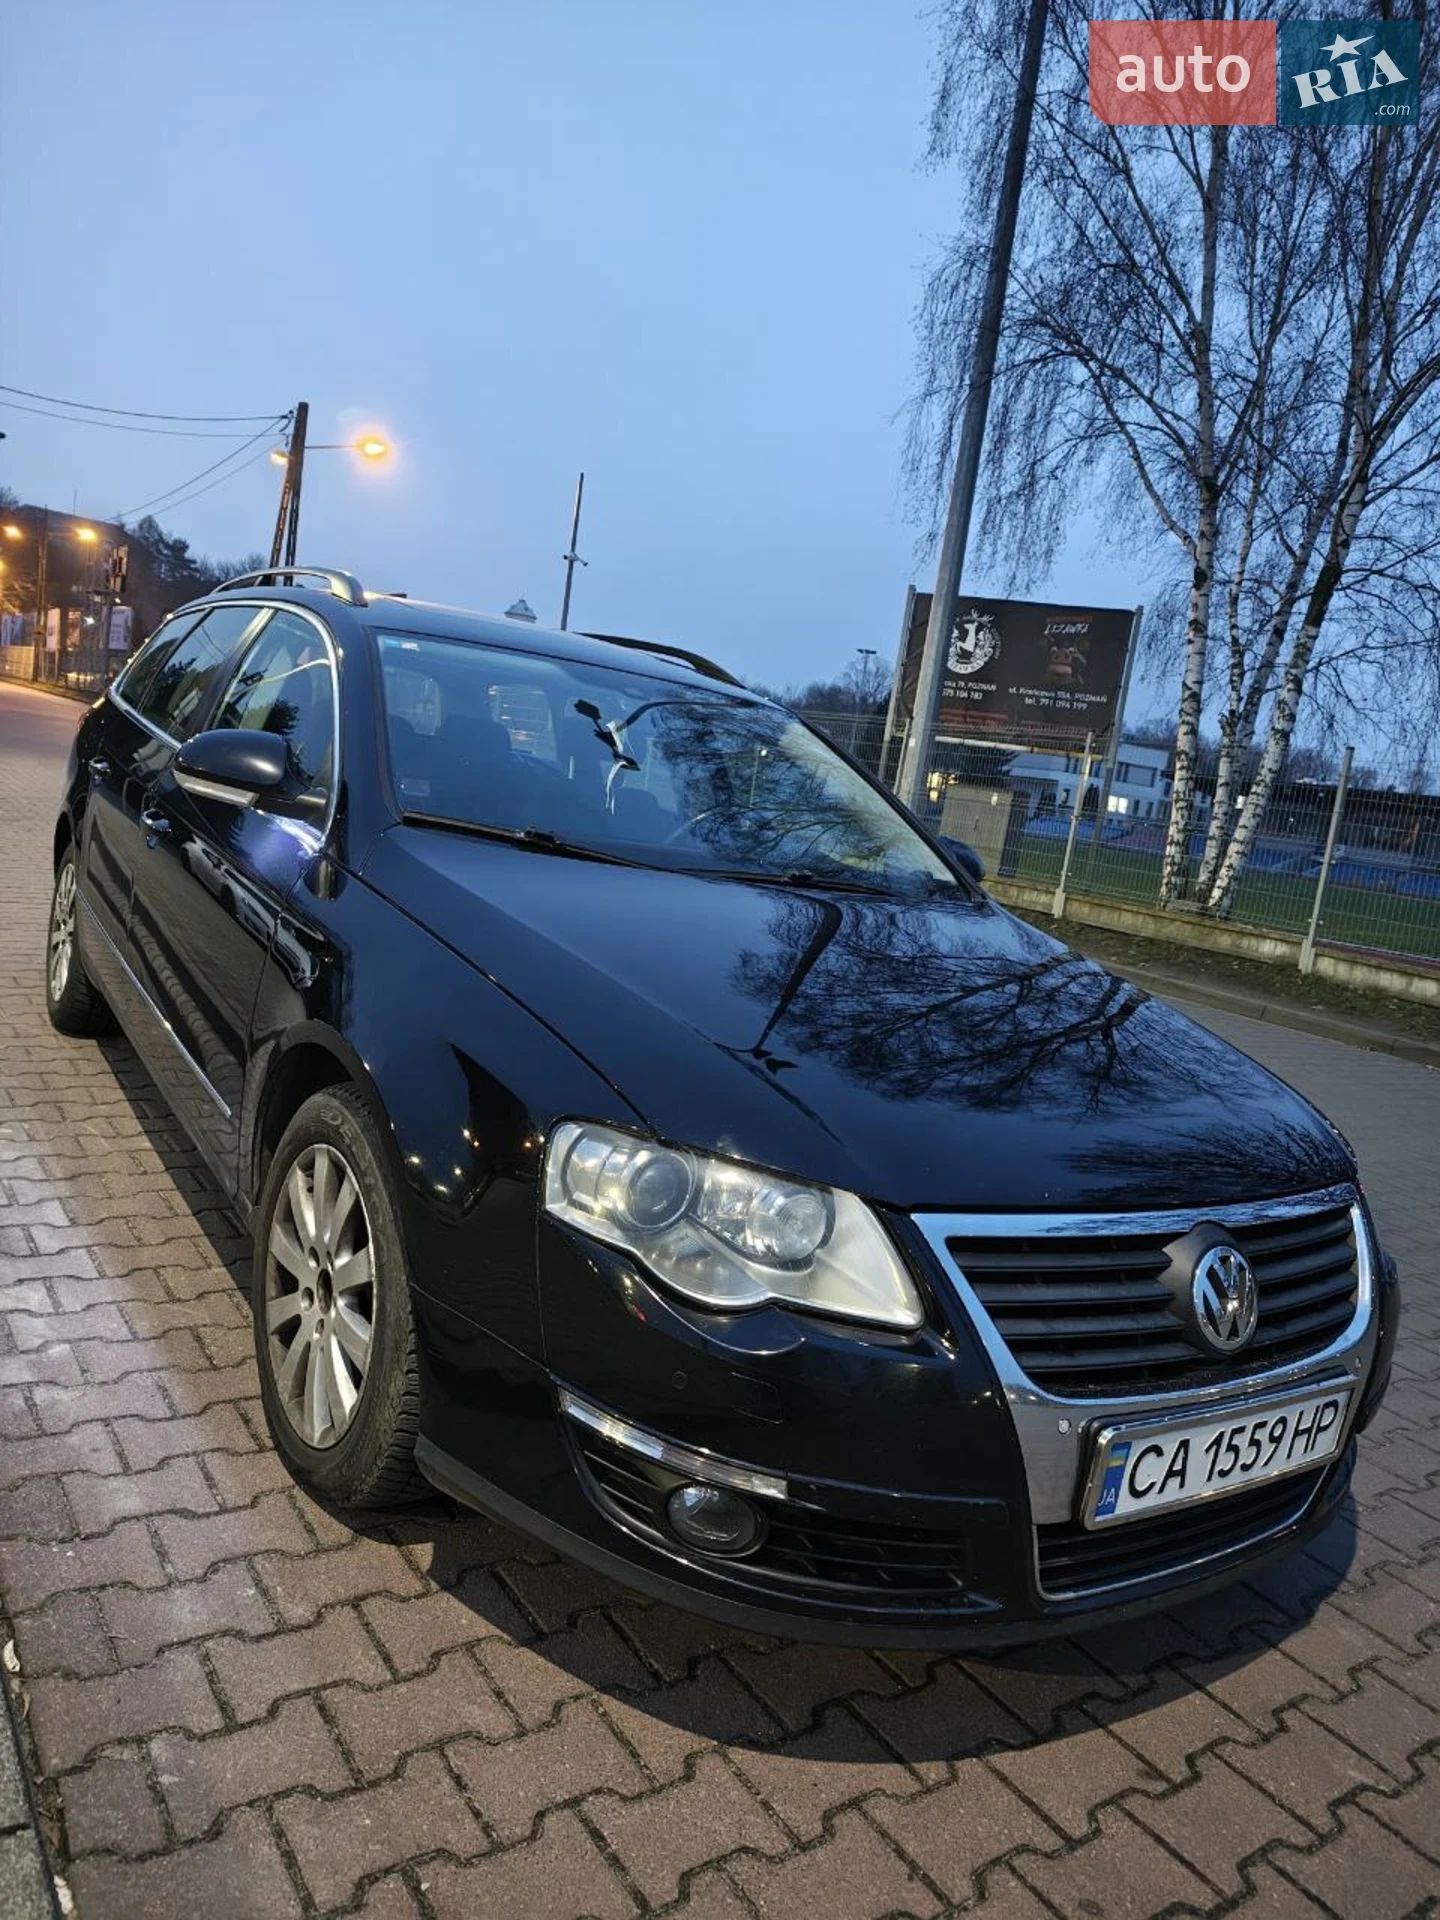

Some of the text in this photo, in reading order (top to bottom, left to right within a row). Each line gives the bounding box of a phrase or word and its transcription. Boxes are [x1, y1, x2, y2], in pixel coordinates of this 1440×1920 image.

[1128, 1399, 1339, 1499] CA 1559 HP
